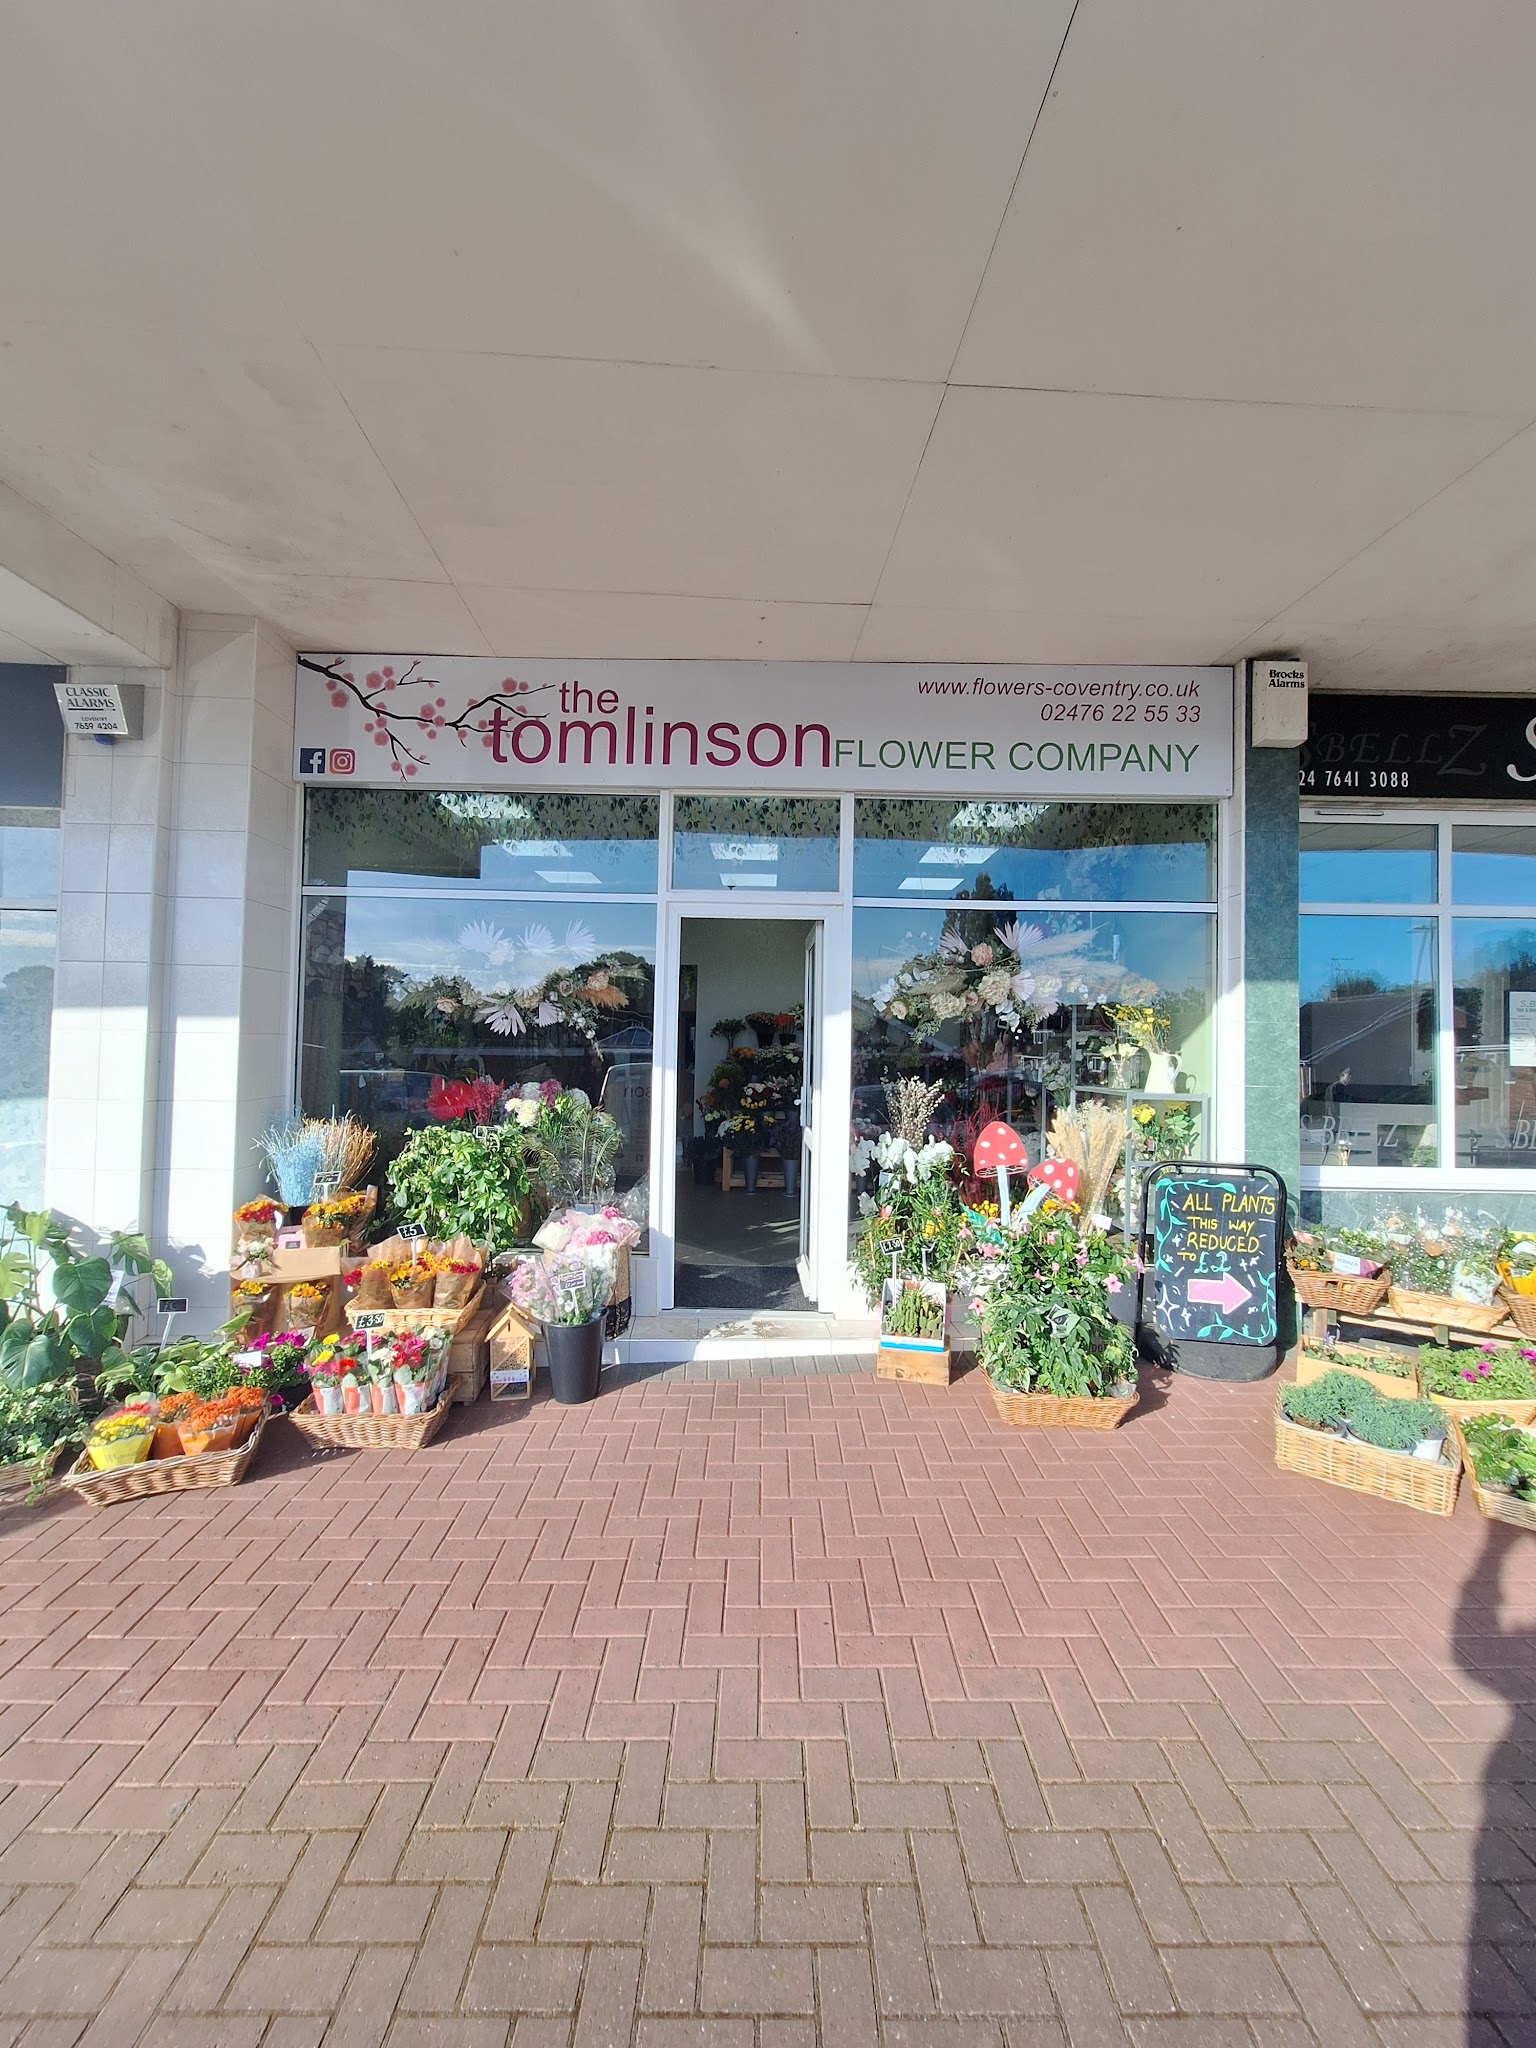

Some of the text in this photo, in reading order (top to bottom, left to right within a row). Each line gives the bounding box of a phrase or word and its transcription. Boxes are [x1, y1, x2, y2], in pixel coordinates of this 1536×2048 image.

[1268, 678, 1306, 689] Alarms
[1269, 669, 1305, 679] Brocks
[65, 686, 111, 698] CLASSIC
[558, 680, 619, 714] the
[917, 678, 1201, 701] www.flowers-coventry.co.uk
[66, 698, 115, 708] ALARMS
[1040, 703, 1201, 724] 02476 22 55 33
[74, 722, 118, 730] 7659 4204
[488, 705, 1200, 773] tomlinson FLOWER COMPANY
[1325, 770, 1359, 787] 7641
[1369, 771, 1409, 788] 3088
[1182, 1192, 1276, 1215] ALL PLANTS
[402, 1226, 418, 1238] £5
[1186, 1216, 1256, 1237] THIS WAY
[1186, 1233, 1260, 1254] REDUCED
[1194, 1251, 1232, 1274] £2
